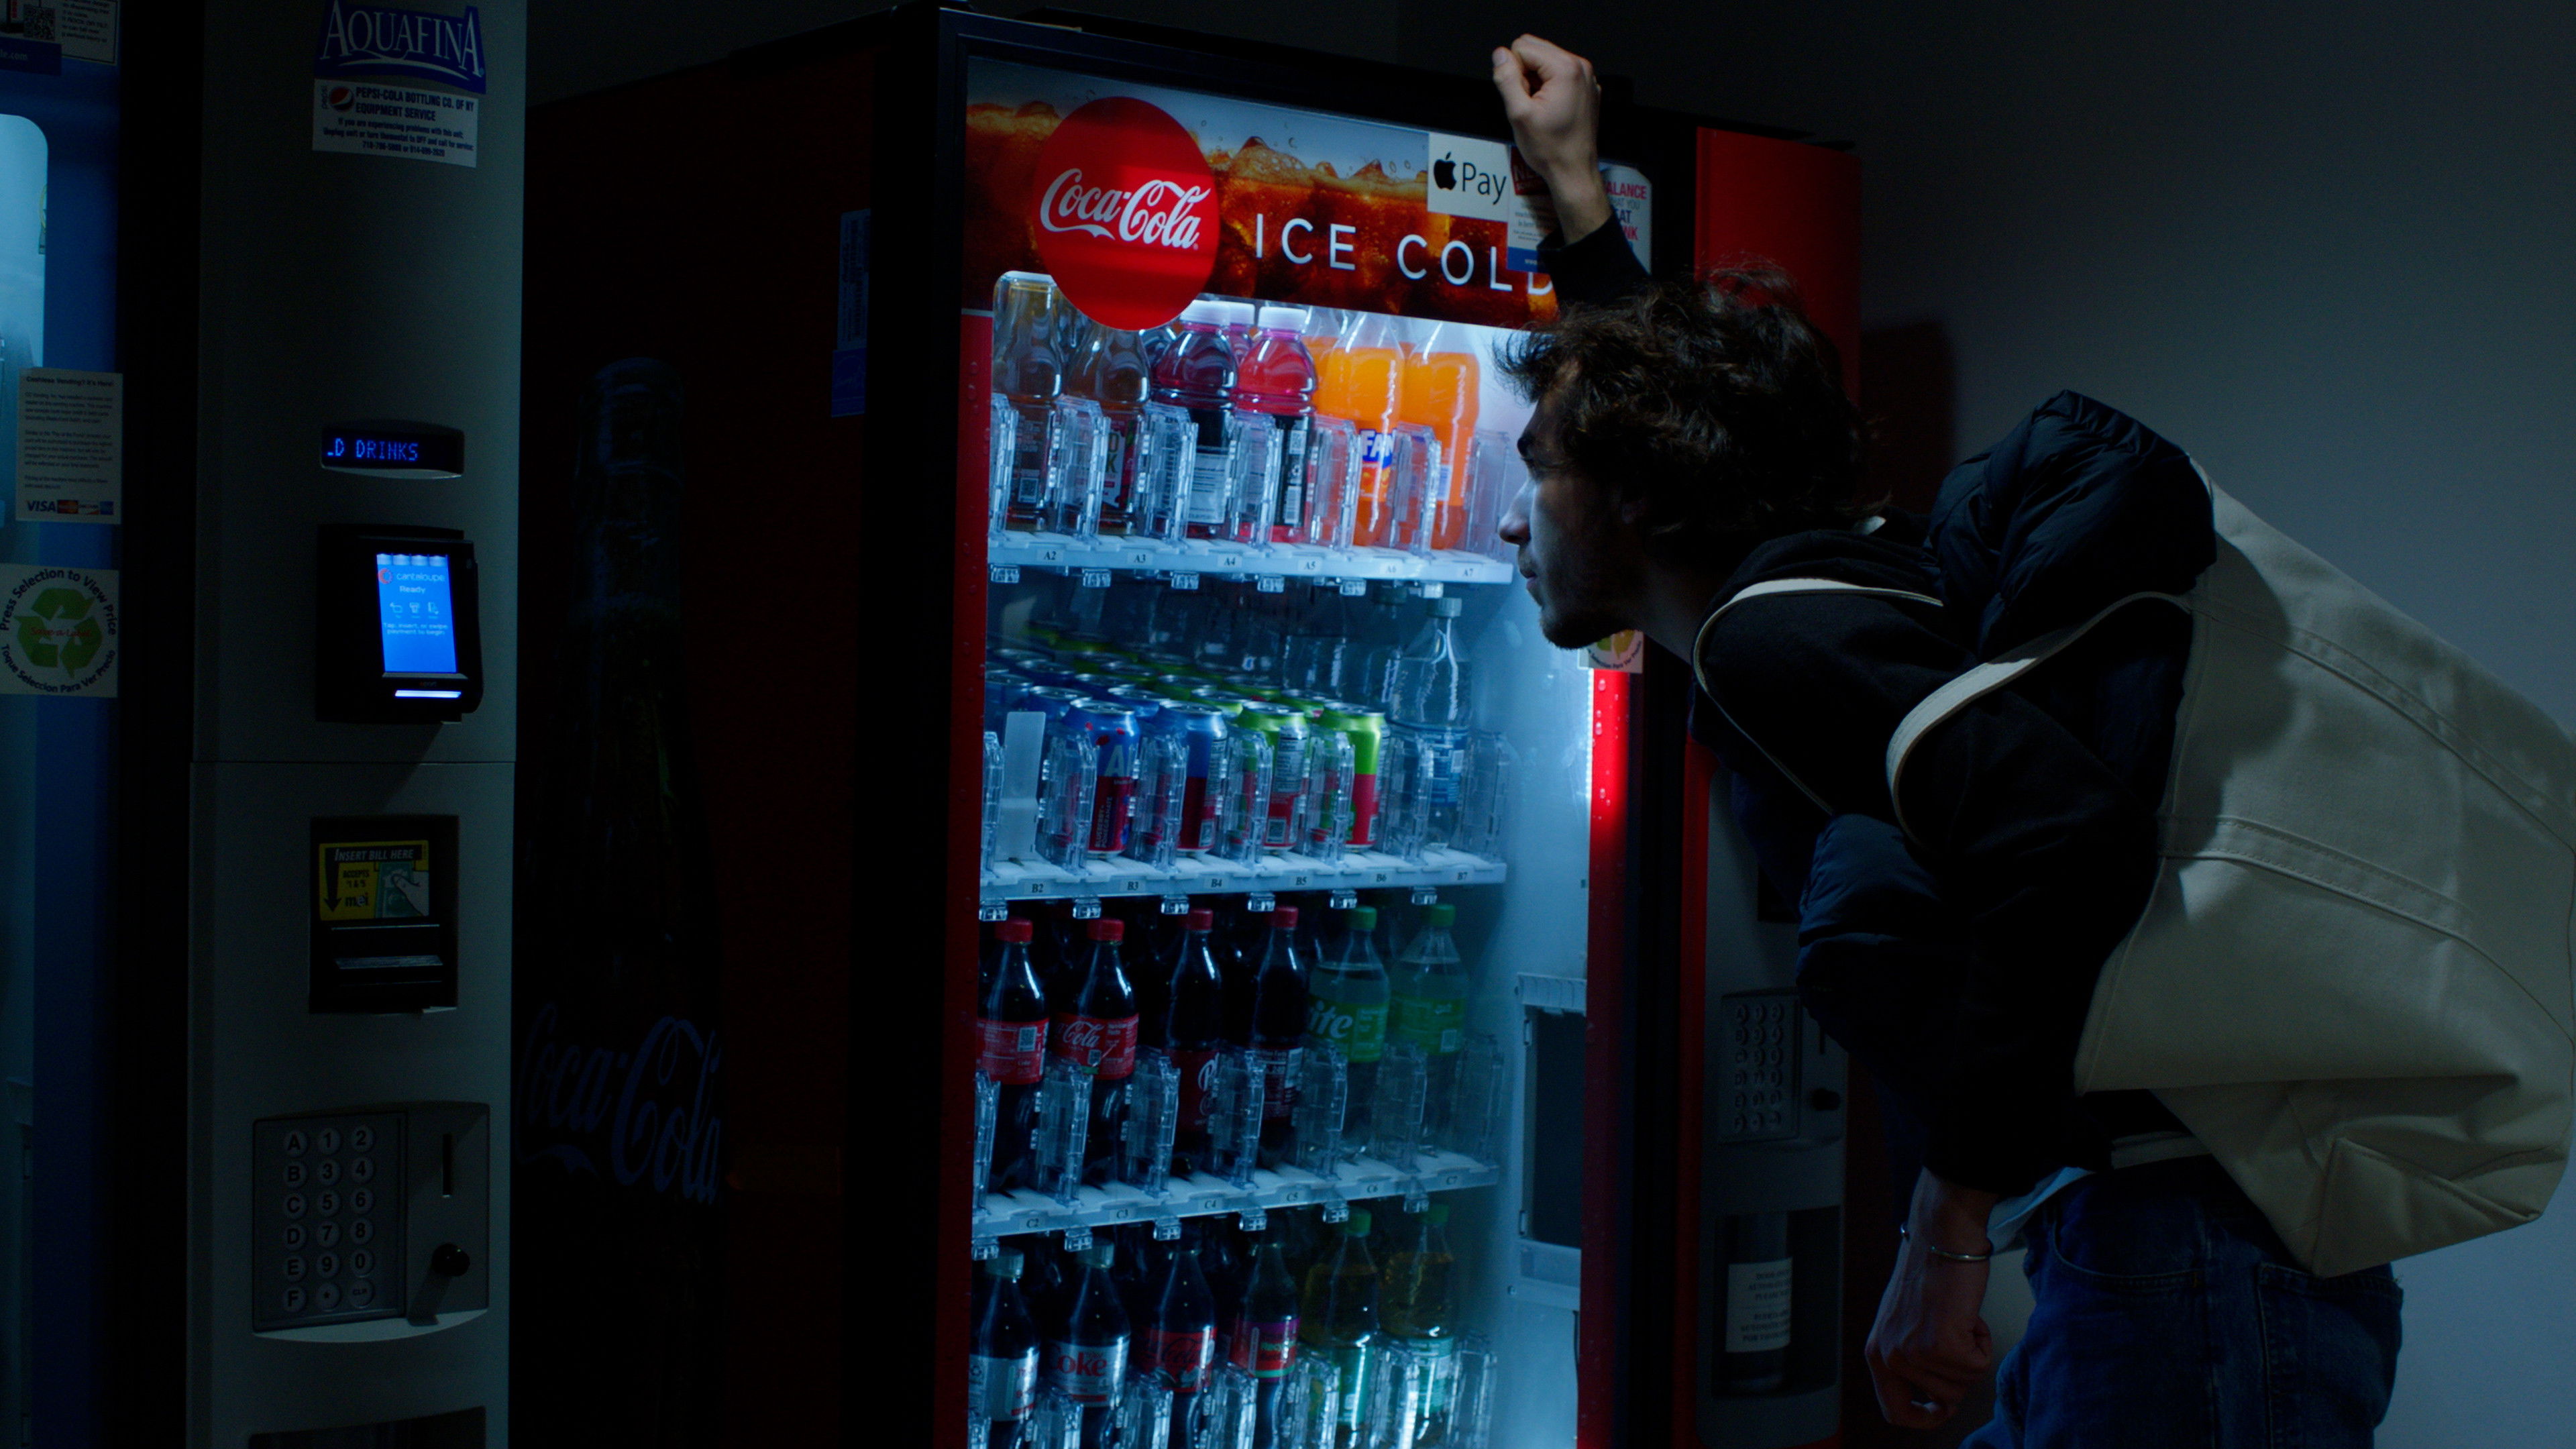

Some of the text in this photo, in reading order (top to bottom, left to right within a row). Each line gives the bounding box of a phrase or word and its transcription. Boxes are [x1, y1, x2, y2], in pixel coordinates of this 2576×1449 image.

[319, 0, 483, 78] AQUAFINA
[356, 87, 402, 102] PEPSI-COLA
[405, 92, 440, 107] BOTTLING
[443, 97, 454, 109] CO.
[455, 99, 464, 110] OF
[356, 103, 436, 121] EQUIPMENT SERVICE
[1462, 162, 1507, 205] Pay
[1606, 181, 1647, 201] ALANCE
[1040, 168, 1212, 250] Coca-Cola
[1255, 213, 1357, 271] ICE
[355, 439, 419, 462] DRINKS
[27, 500, 57, 512] VISA
[1044, 551, 1057, 561] A2
[1134, 554, 1146, 564] A3
[1224, 557, 1236, 566] A4
[1303, 561, 1316, 570] A5
[1462, 568, 1474, 578] A7
[399, 585, 427, 594] Ready
[0, 569, 118, 635] Press Selection to View Price
[2, 644, 19, 674] Toque
[60, 683, 81, 693] Para
[81, 676, 97, 687] Ver
[96, 650, 115, 677] Precio
[335, 848, 415, 862] INSERT BILL HERE
[1211, 877, 1223, 888] B4
[1295, 876, 1307, 885] B5
[1376, 873, 1387, 883] B6
[1457, 872, 1468, 881] B7
[1032, 883, 1044, 893] B2
[1127, 880, 1139, 891] B3
[1308, 999, 1354, 1040] ite
[288, 1130, 366, 1150] A 1 2
[288, 1161, 366, 1182] B 3 4
[1446, 1175, 1458, 1185] C7
[1366, 1183, 1379, 1193] C6
[287, 1192, 366, 1213] C 5 6
[1286, 1192, 1298, 1202] C5
[1204, 1199, 1217, 1210] C4
[1116, 1208, 1129, 1219] C3
[1026, 1218, 1039, 1229] C2
[288, 1223, 366, 1244] D 7 8
[288, 1254, 366, 1276] E 9 0
[288, 1290, 299, 1307] F
